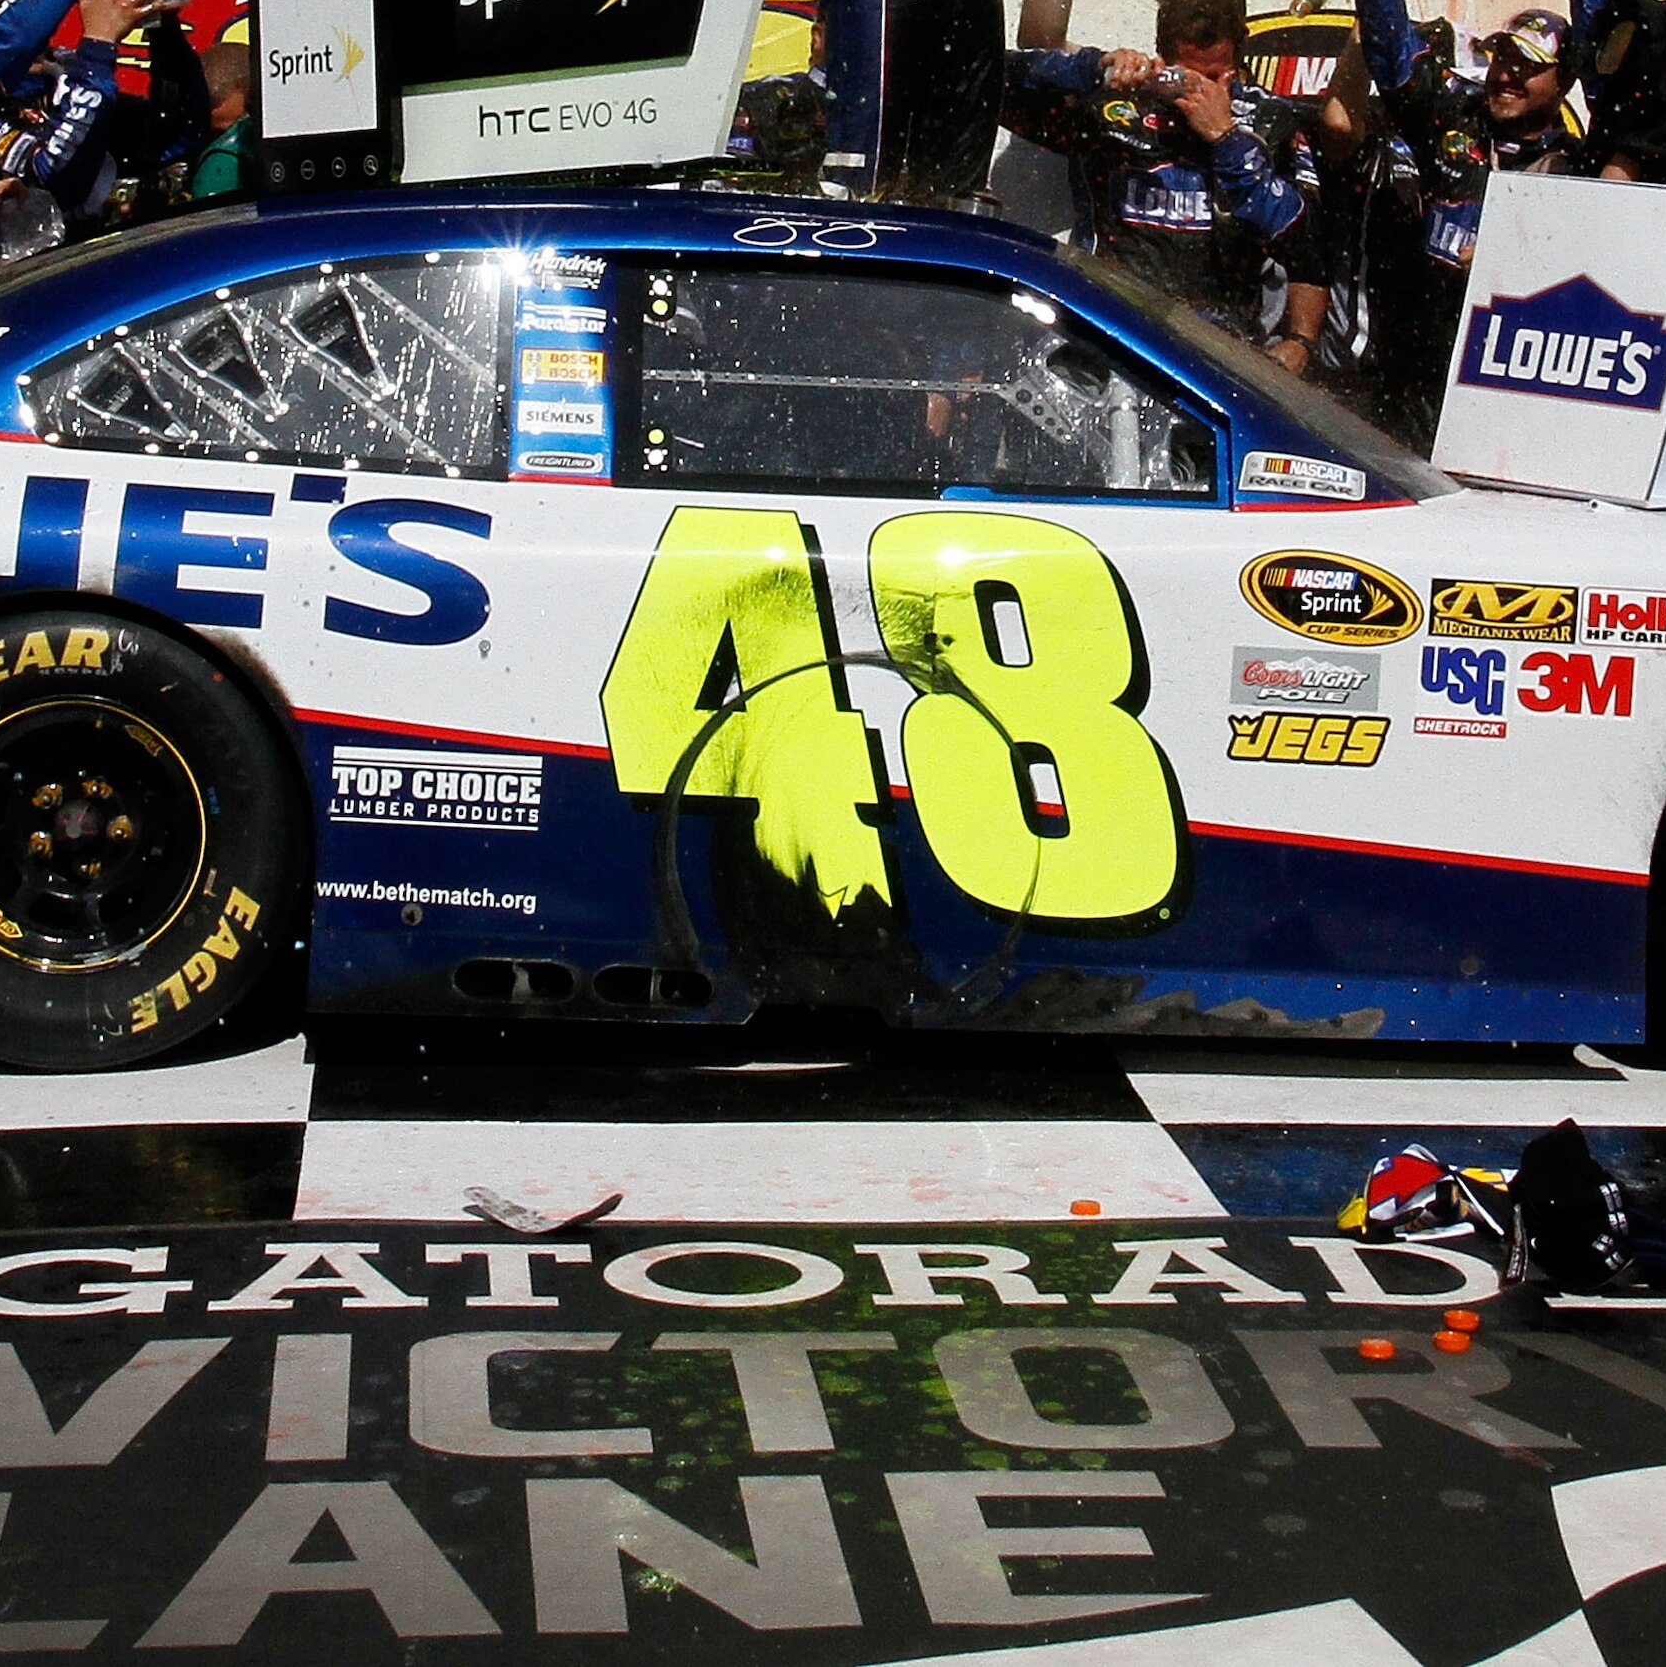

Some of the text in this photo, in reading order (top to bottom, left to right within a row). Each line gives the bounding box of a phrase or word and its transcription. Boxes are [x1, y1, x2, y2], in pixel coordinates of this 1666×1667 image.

[270, 46, 333, 83] Sprint
[560, 102, 612, 131] EVO
[623, 98, 657, 124] 4G
[531, 250, 607, 274] Hendrick
[550, 354, 598, 365] BOSCH
[1480, 314, 1654, 396] LOWE'S
[549, 368, 599, 378] BOSCH
[526, 411, 594, 424] SIEMENS
[1290, 460, 1345, 482] NASCAR
[1249, 475, 1353, 495] RACE CAR
[1291, 569, 1354, 590] NASCAR
[1301, 591, 1362, 615] Sprint
[1306, 624, 1399, 638] CUP SERIES
[1586, 629, 1616, 641] HP
[1242, 661, 1369, 692] Coors LIGHT
[1421, 647, 1506, 715] USG
[1517, 652, 1635, 717] 3M
[1258, 687, 1349, 704] POLE
[600, 505, 1194, 938] 48
[1415, 720, 1501, 736] SHEETROCK
[1233, 715, 1388, 766] JEGS
[332, 766, 541, 804] TOP CHOICE
[331, 799, 539, 823] LUMBER PRODUCTS
[317, 880, 537, 914] www.bethematch.org
[131, 887, 261, 1032] EAGLE
